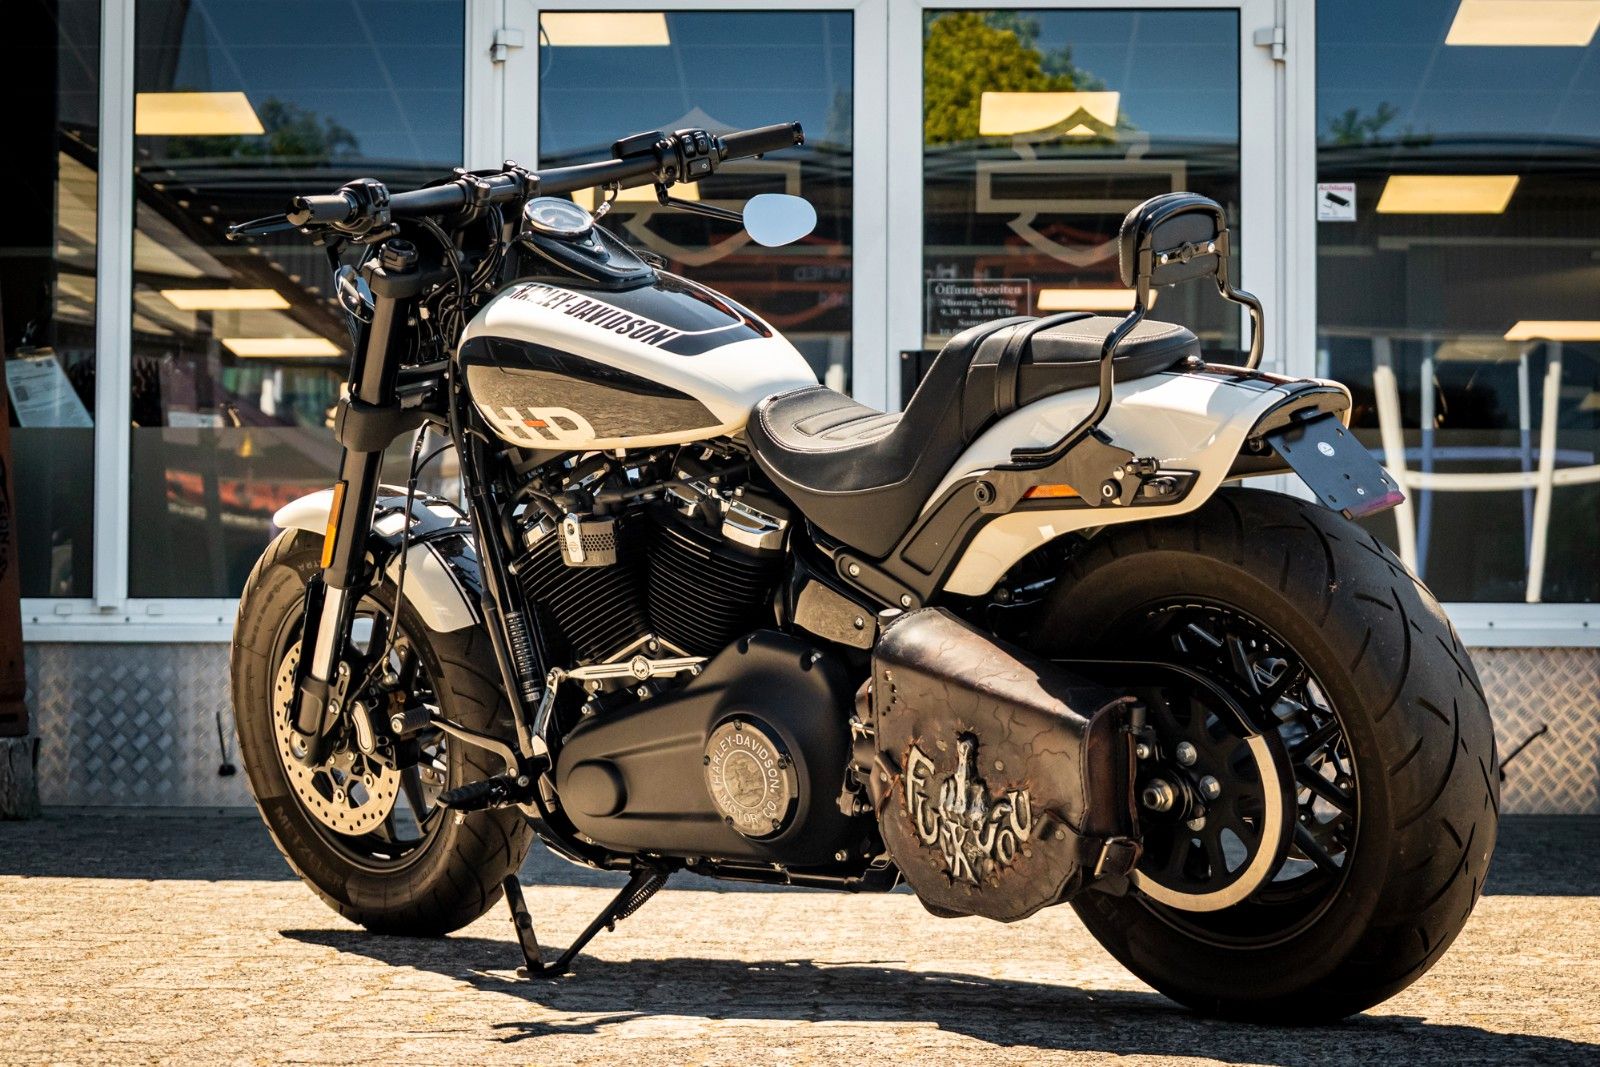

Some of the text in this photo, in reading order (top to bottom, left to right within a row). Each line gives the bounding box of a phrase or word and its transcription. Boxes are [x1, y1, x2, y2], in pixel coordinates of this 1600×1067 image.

[934, 283, 1022, 296] Öffnungszeiten
[509, 283, 678, 346] HLEY-DAVIDSON
[711, 733, 780, 789] HARLEY-DAVIDSON
[720, 794, 759, 823] MOTOR
